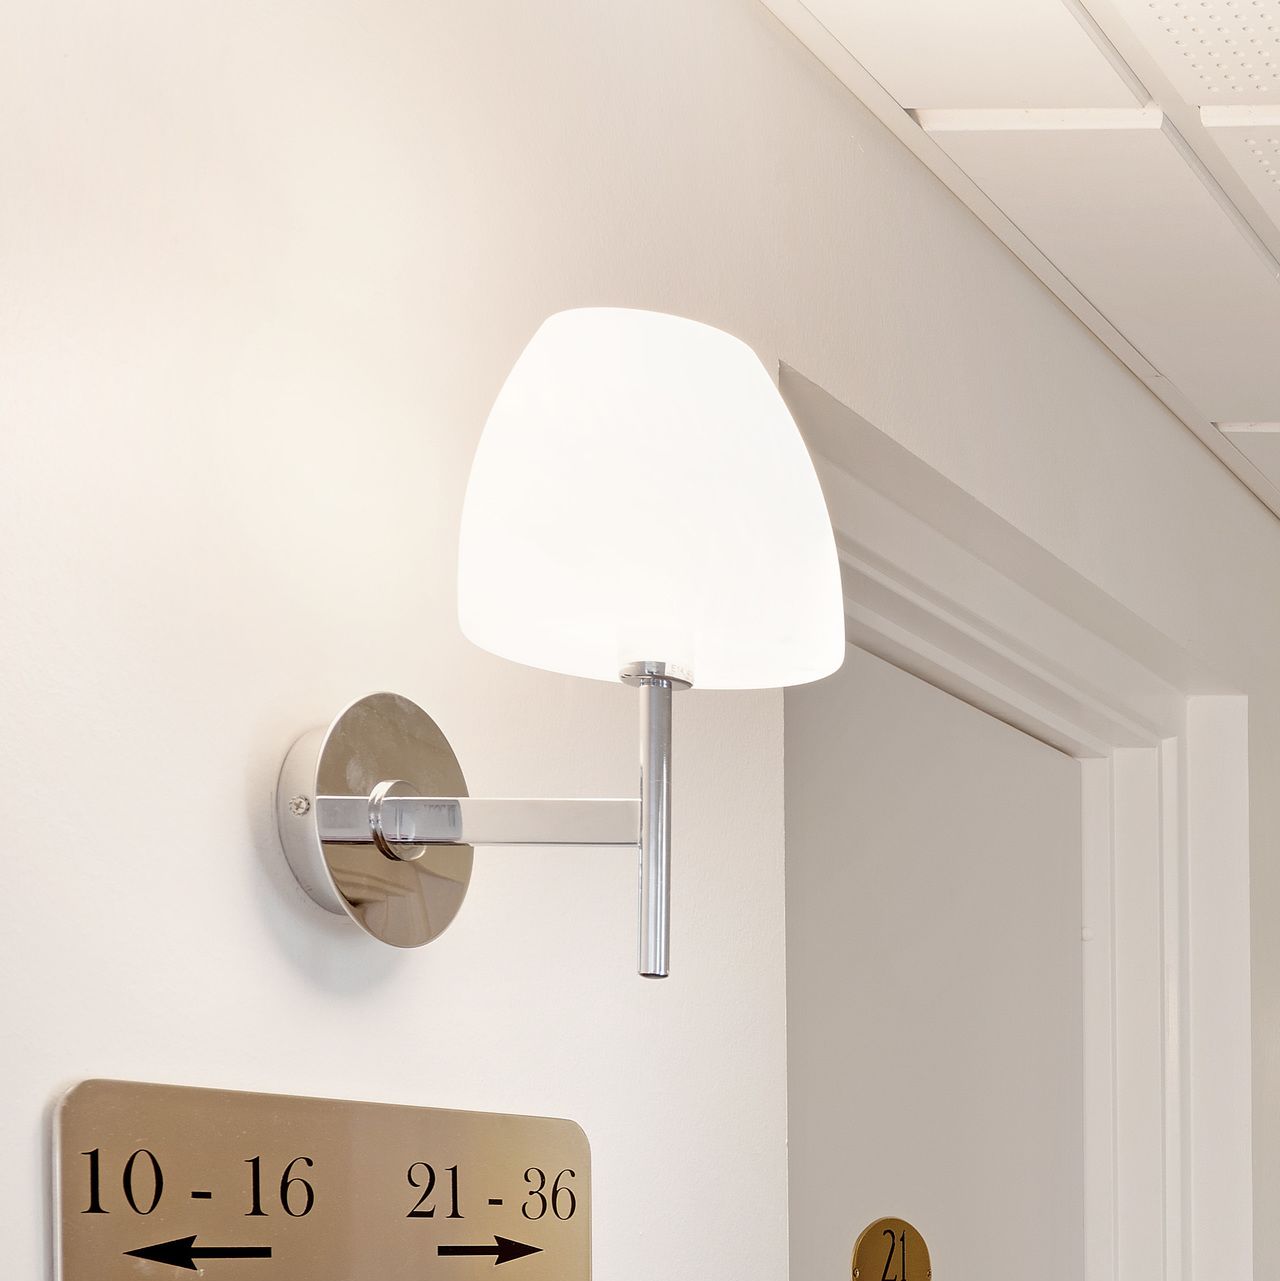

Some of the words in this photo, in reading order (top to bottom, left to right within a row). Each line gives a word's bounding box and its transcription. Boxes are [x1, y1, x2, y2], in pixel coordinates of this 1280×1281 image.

[80, 1147, 165, 1216] 10
[243, 1154, 316, 1218] 16
[405, 1160, 466, 1220] 21
[520, 1166, 578, 1222] 36
[881, 1229, 907, 1281] 21
